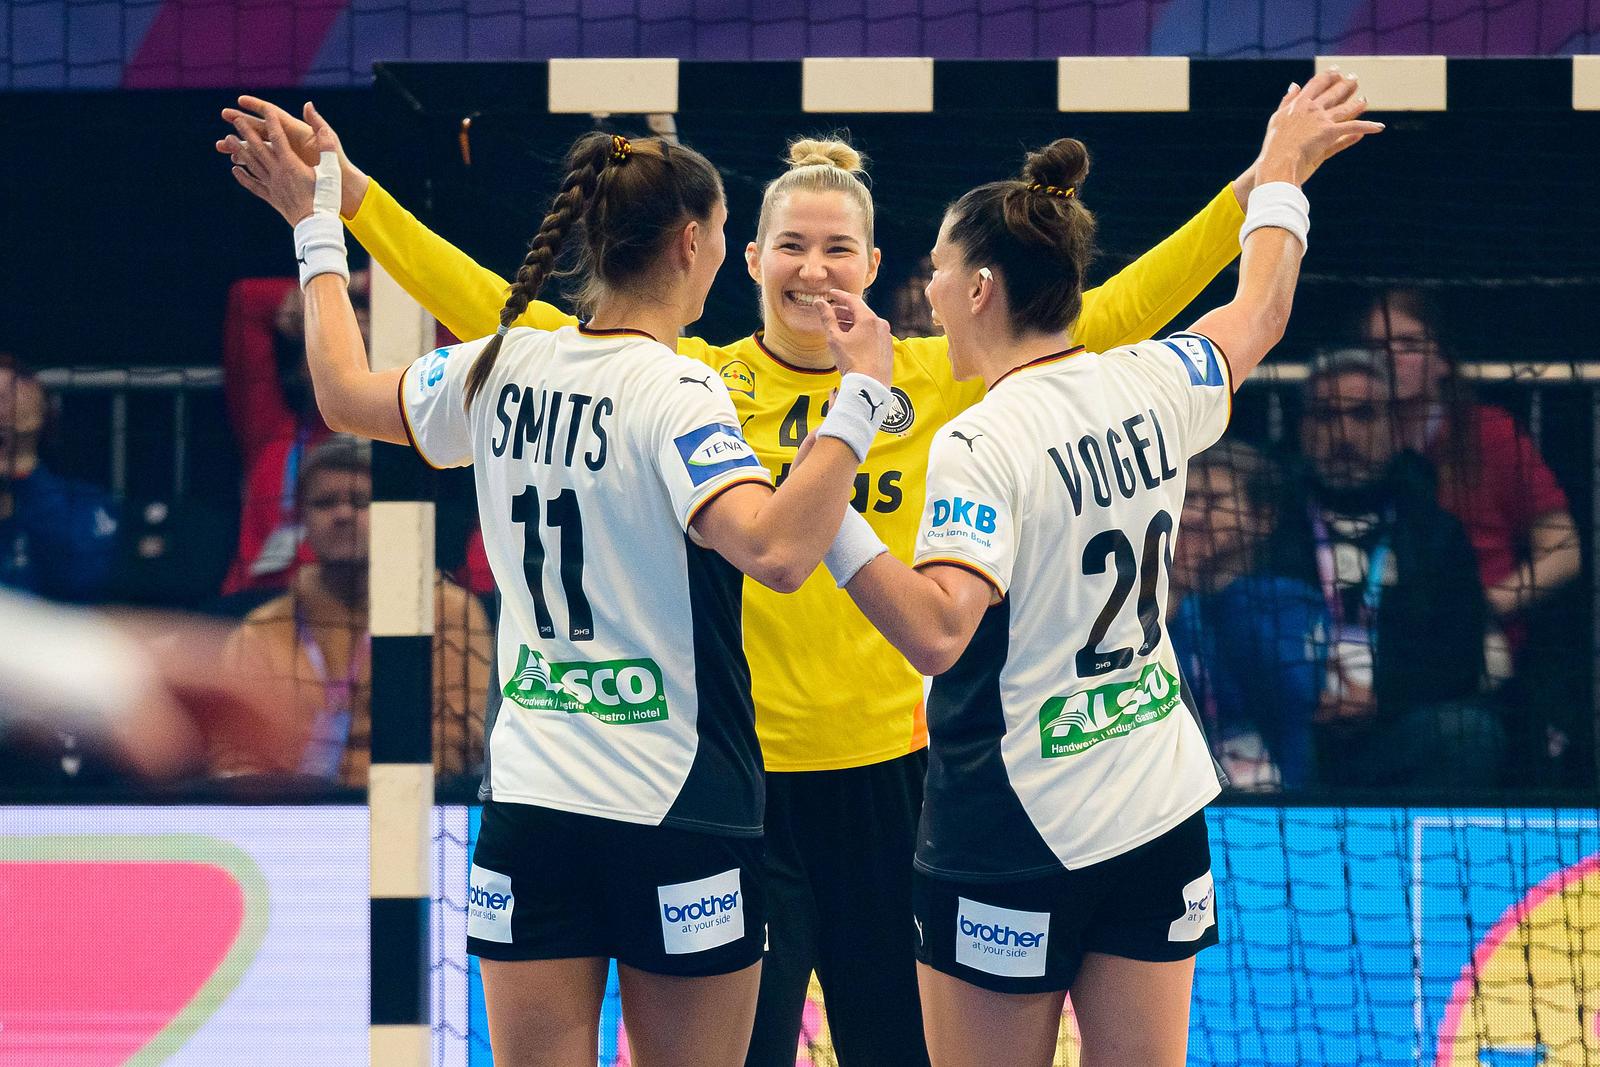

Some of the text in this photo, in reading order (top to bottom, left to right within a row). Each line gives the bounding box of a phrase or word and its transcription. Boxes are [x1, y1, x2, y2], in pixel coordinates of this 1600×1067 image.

[491, 383, 614, 472] SMITS
[778, 394, 830, 447] 4
[702, 441, 744, 459] TENA
[1047, 408, 1178, 517] VOGEL
[932, 496, 997, 534] DKB
[927, 530, 945, 538] Das
[511, 484, 595, 642] 11
[1074, 509, 1173, 678] 20
[632, 708, 661, 720] Hotel
[470, 885, 512, 910] other
[663, 890, 739, 923] brother
[681, 914, 731, 934] at your side
[960, 914, 1045, 948] brother
[972, 941, 1028, 958] at your side
